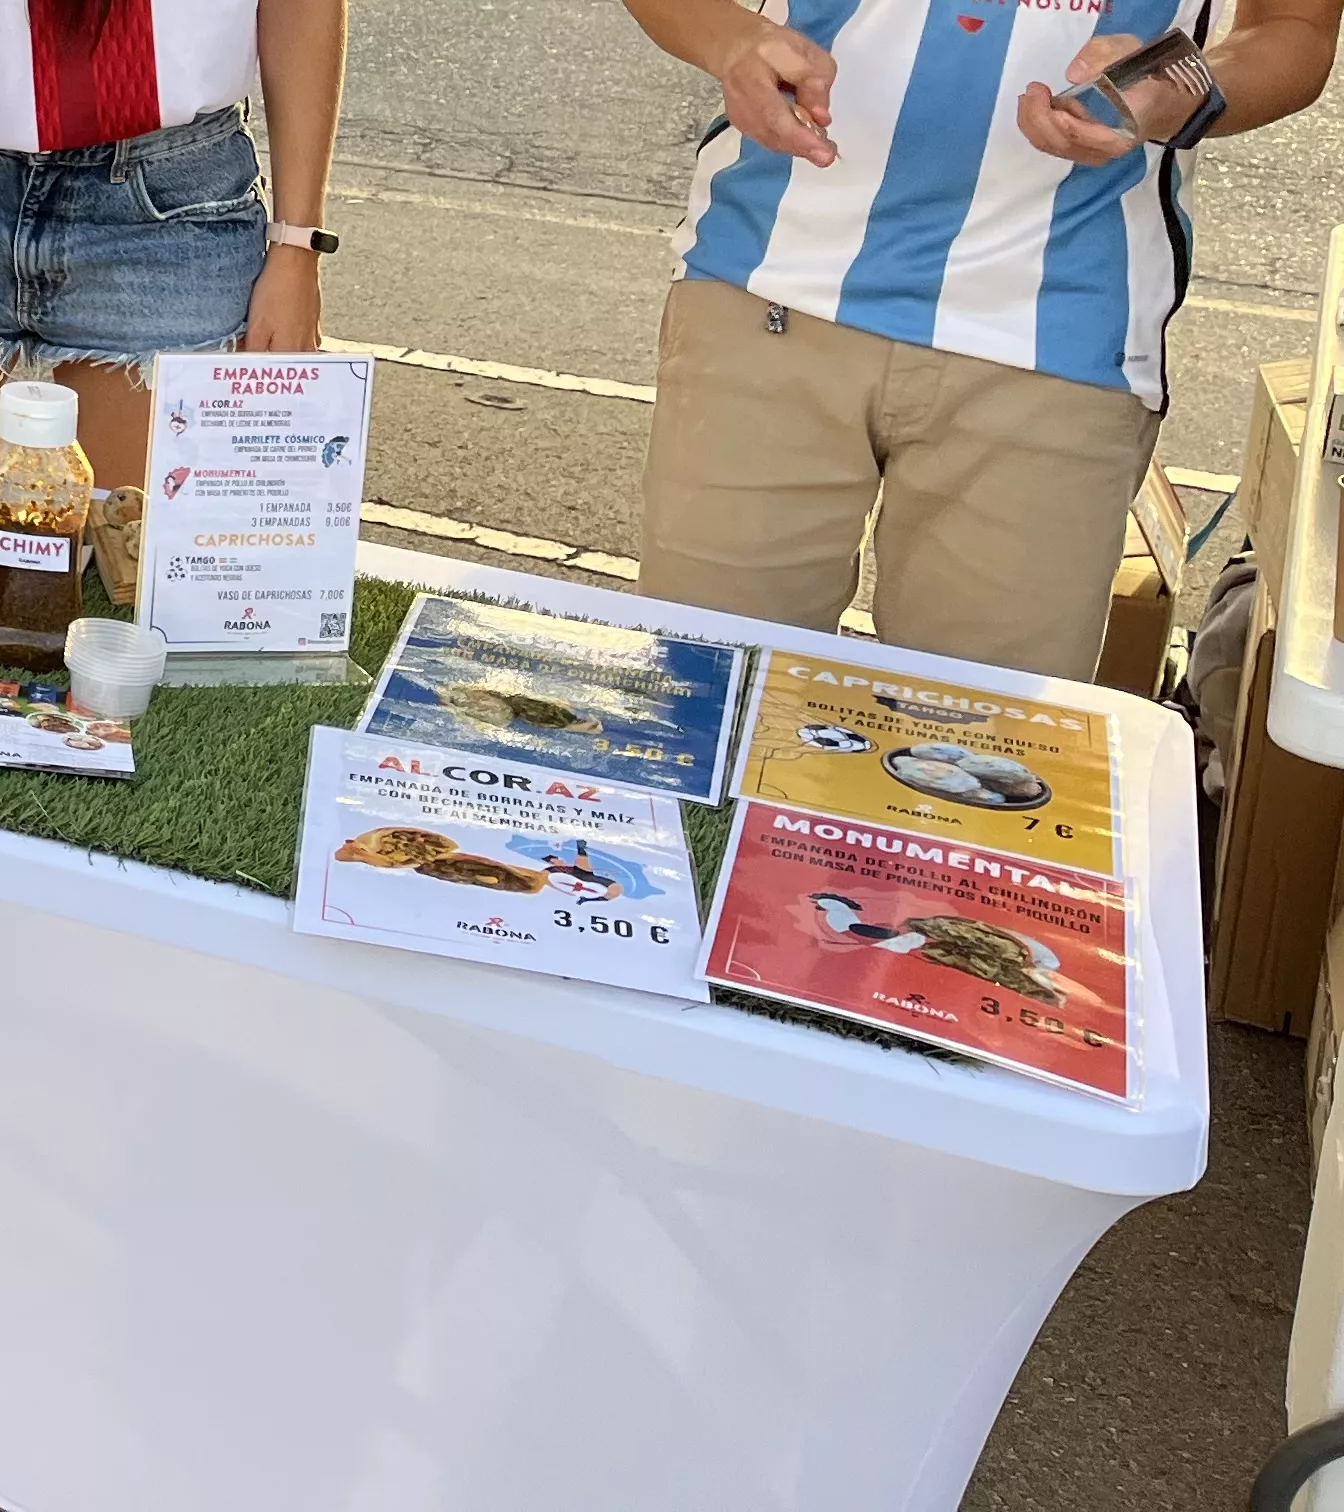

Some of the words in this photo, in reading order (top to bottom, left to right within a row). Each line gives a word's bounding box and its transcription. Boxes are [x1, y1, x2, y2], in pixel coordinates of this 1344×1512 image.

[213, 367, 320, 381] EMPANADAS
[231, 381, 304, 396] RABONA
[232, 435, 281, 444] BARRILETE
[285, 433, 326, 444] CÓSMICO
[194, 469, 257, 478] MONUMENTAL
[266, 502, 312, 514] EMPANADA
[327, 502, 352, 514] 3,50€
[251, 516, 257, 528] 3
[259, 516, 311, 528] EMPANADAS
[194, 532, 316, 548] CAPRICHOSAS
[185, 556, 216, 565] TANGO
[217, 590, 239, 601] VASO
[242, 590, 251, 601] DE
[254, 589, 312, 601] CAPRICHOSAS
[319, 589, 345, 602] 7,00€
[224, 620, 271, 631] RABONA
[787, 664, 1086, 732] CAPRICHOSAS
[896, 700, 965, 720] TANGO
[807, 700, 877, 722] BOLITAS
[883, 713, 906, 726] DE
[911, 719, 956, 736] YUCA
[962, 728, 998, 744] CON
[1004, 735, 1060, 754] QUESO
[838, 715, 847, 725] Y
[853, 717, 951, 745] ACEITUNAS
[957, 737, 1027, 758] NEGRAS
[378, 754, 602, 803] AL.COR.AZ
[349, 772, 443, 796] EMPANADA
[448, 786, 471, 799] DE
[477, 790, 568, 816] BORRAJAS
[573, 805, 585, 817] Y
[591, 808, 636, 827] MAÍZ
[378, 787, 414, 802] CON
[418, 792, 513, 817] BECHAMEL
[519, 807, 541, 821] DE
[547, 813, 605, 832] LECHE
[422, 803, 443, 816] DE
[447, 807, 560, 836] ALMENDRAS
[886, 803, 963, 826] RABONA
[1021, 814, 1040, 831] 7
[1055, 822, 1075, 840] €
[760, 833, 860, 864] EMPANADA
[865, 854, 889, 870] DE
[895, 860, 953, 884] POLLO
[958, 875, 980, 892] AL
[988, 883, 1102, 925] CHILINDRÓN
[771, 848, 805, 864] CON
[810, 855, 855, 875] MASA
[861, 866, 881, 880] DE
[886, 871, 975, 902] PIMIENTOS
[980, 893, 1010, 911] DEL
[1016, 904, 1091, 935] PIQUILLO
[456, 918, 538, 944] RABONA
[552, 908, 634, 940] 3,50
[650, 924, 670, 945] €
[872, 991, 960, 1024] RABONA
[980, 996, 1065, 1036] 3,50
